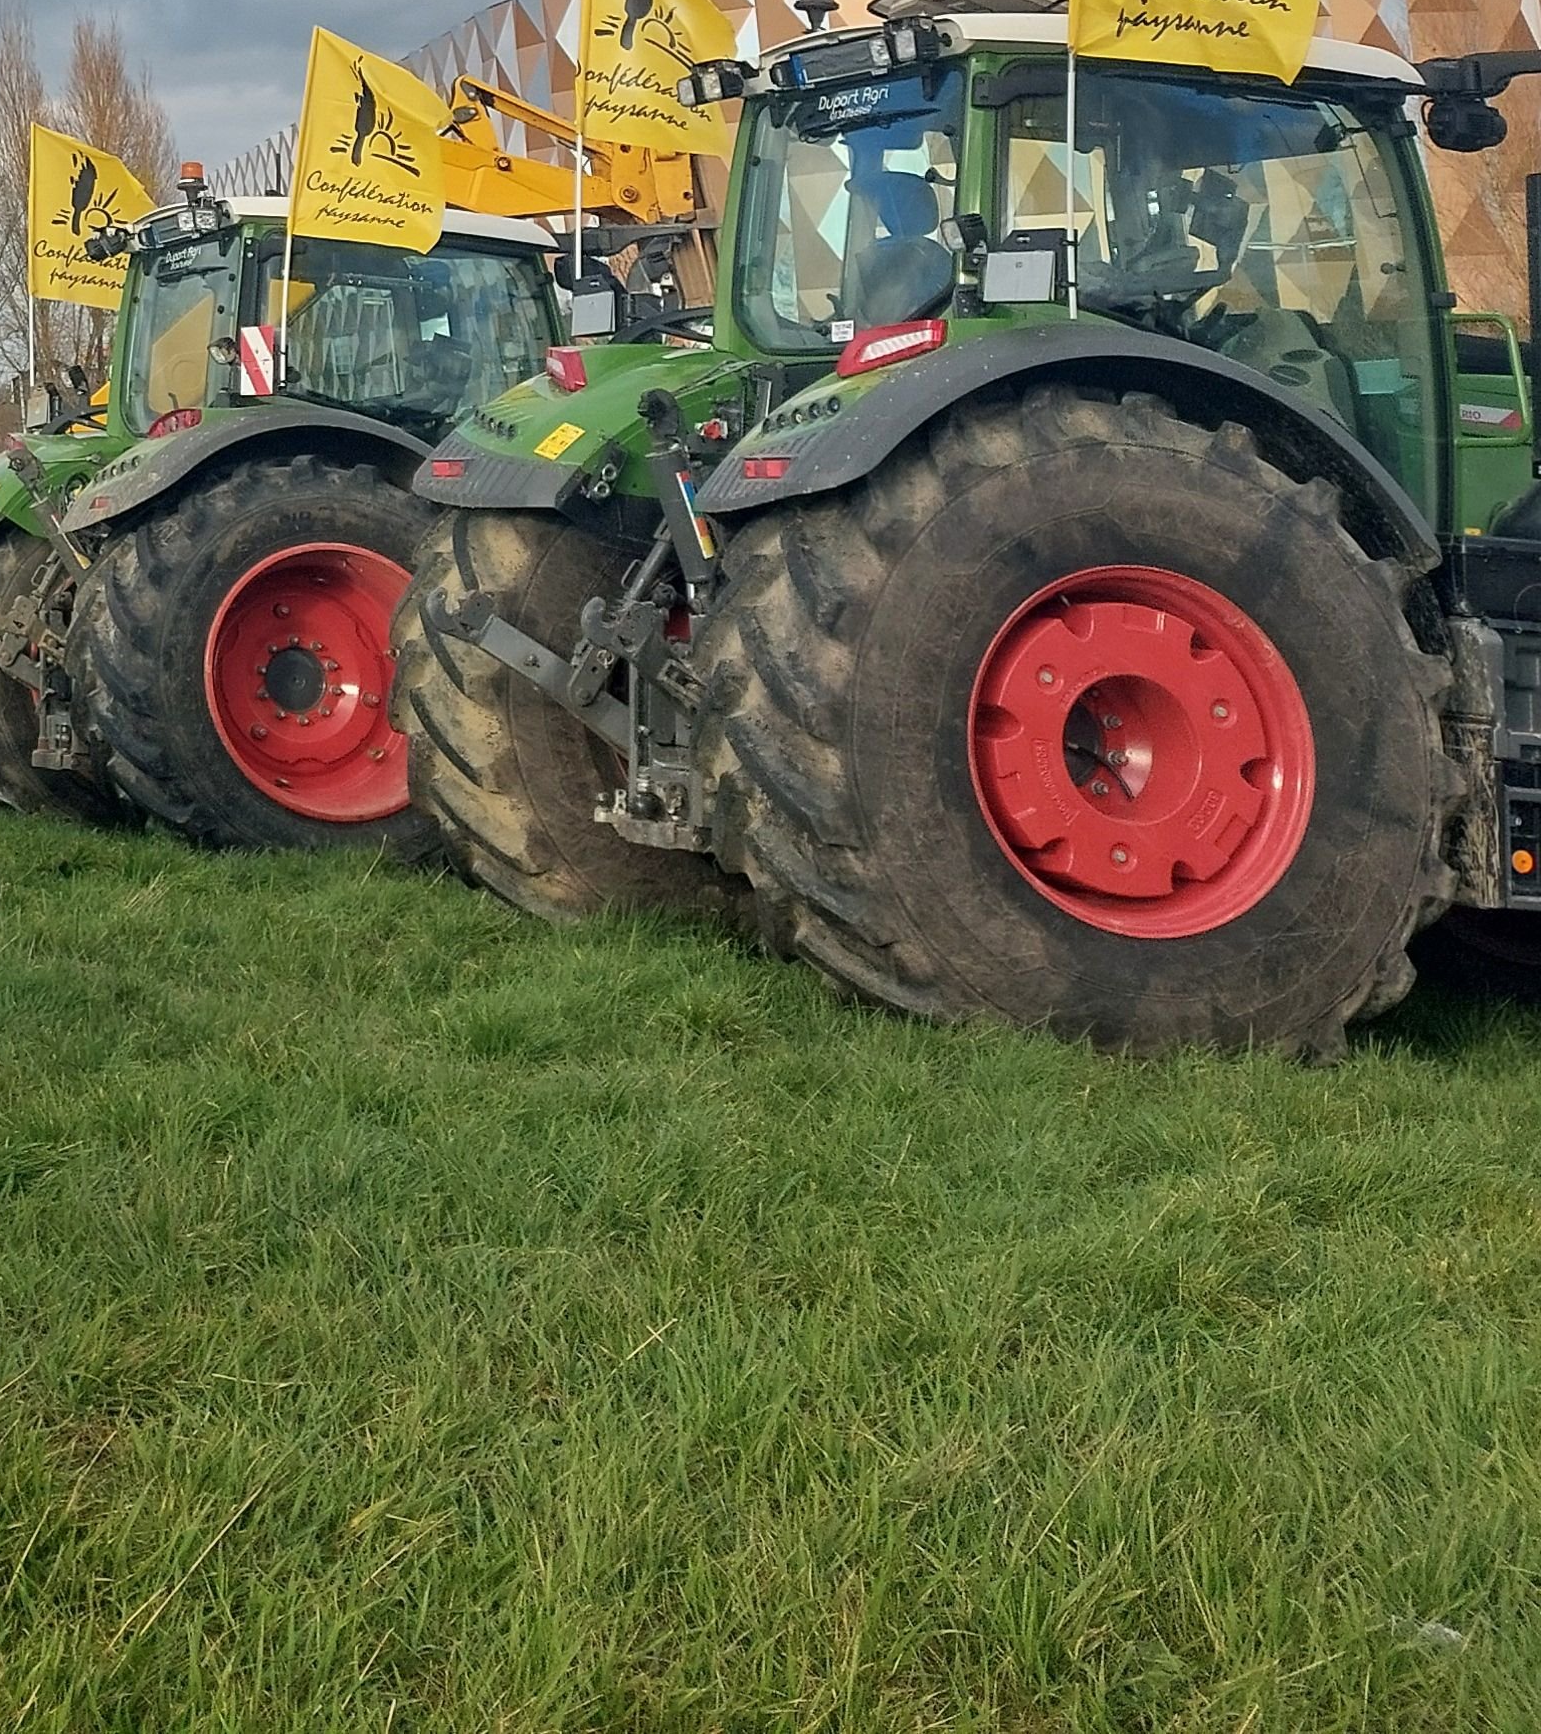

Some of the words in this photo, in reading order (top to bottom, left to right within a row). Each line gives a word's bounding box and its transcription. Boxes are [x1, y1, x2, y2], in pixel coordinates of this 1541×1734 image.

[1116, 7, 1250, 42] paysanne
[584, 94, 689, 130] paysanne
[862, 84, 890, 105] Agri
[306, 170, 434, 214] Confédération
